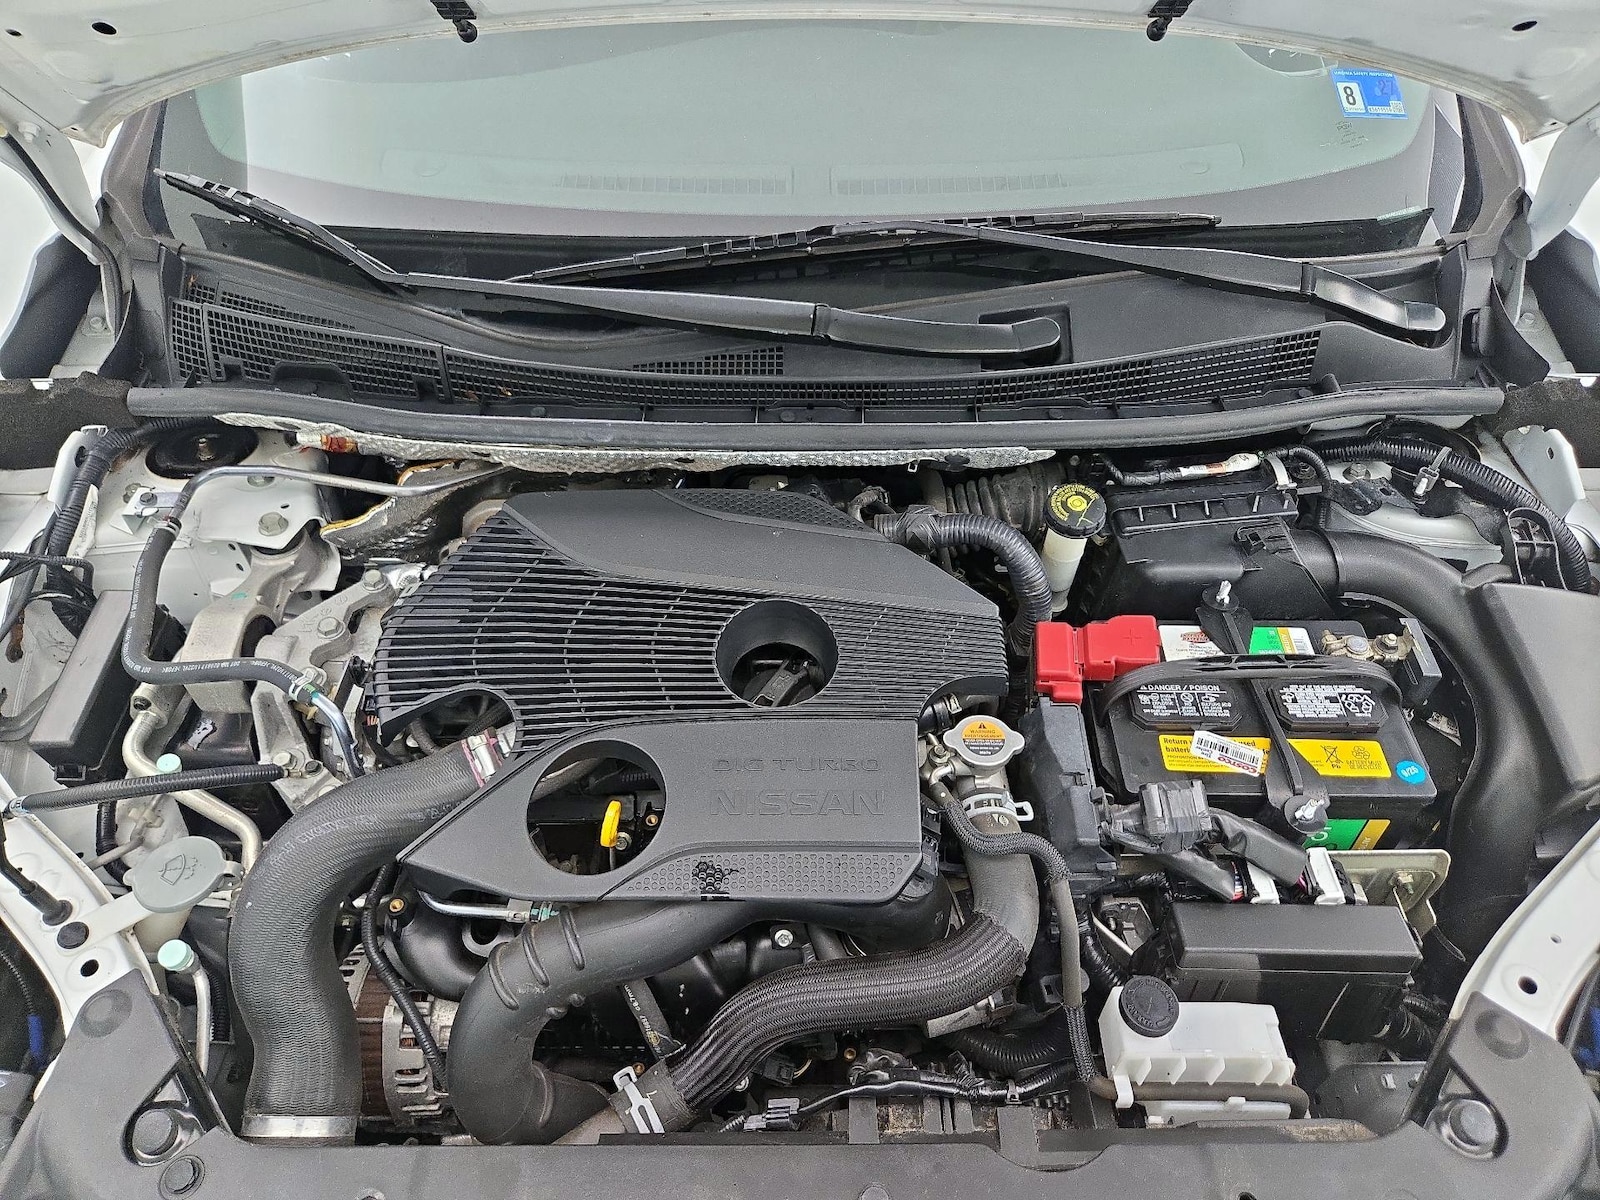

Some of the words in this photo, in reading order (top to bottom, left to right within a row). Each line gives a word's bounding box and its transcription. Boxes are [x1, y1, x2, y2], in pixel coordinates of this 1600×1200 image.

[1343, 86, 1356, 106] 8
[1189, 684, 1220, 692] POISON
[1163, 737, 1188, 745] Return
[712, 758, 764, 772] DIG
[772, 757, 881, 772] TURBO
[1217, 756, 1257, 774] COSTCO
[709, 789, 885, 816] NISSAN
